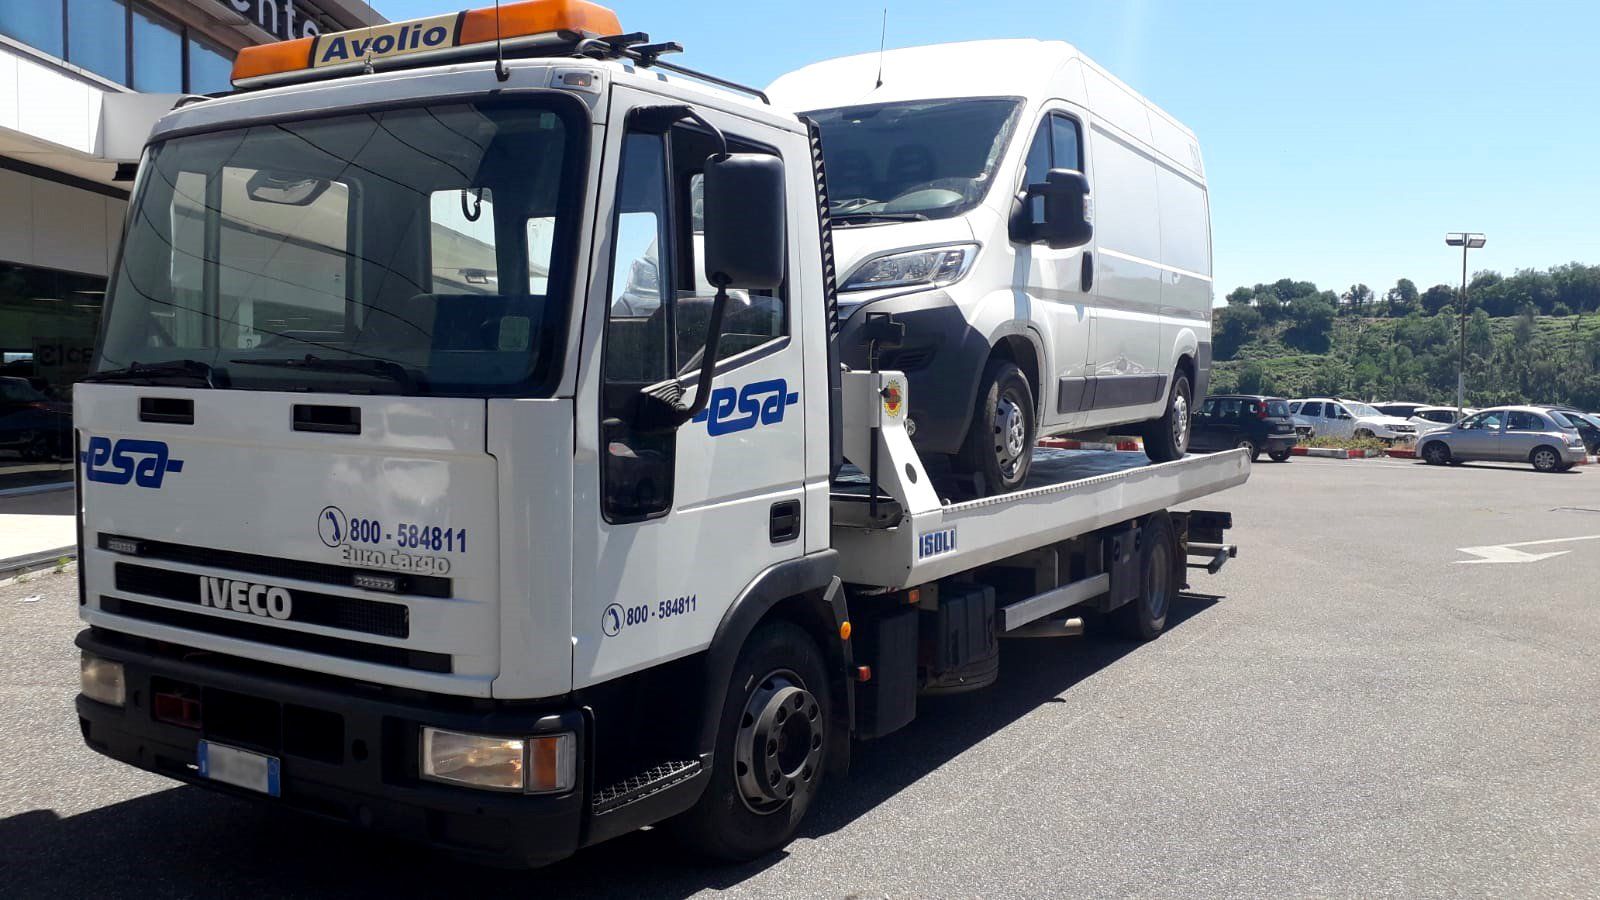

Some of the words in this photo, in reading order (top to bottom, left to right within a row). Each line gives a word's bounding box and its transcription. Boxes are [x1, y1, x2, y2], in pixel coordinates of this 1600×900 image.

[321, 24, 448, 62] Avolio
[350, 518, 381, 544] 800
[397, 523, 467, 553] 584811
[919, 529, 956, 560] ISOLI
[200, 575, 292, 620] IVECO
[626, 604, 648, 626] 800
[658, 594, 696, 619] 584811
